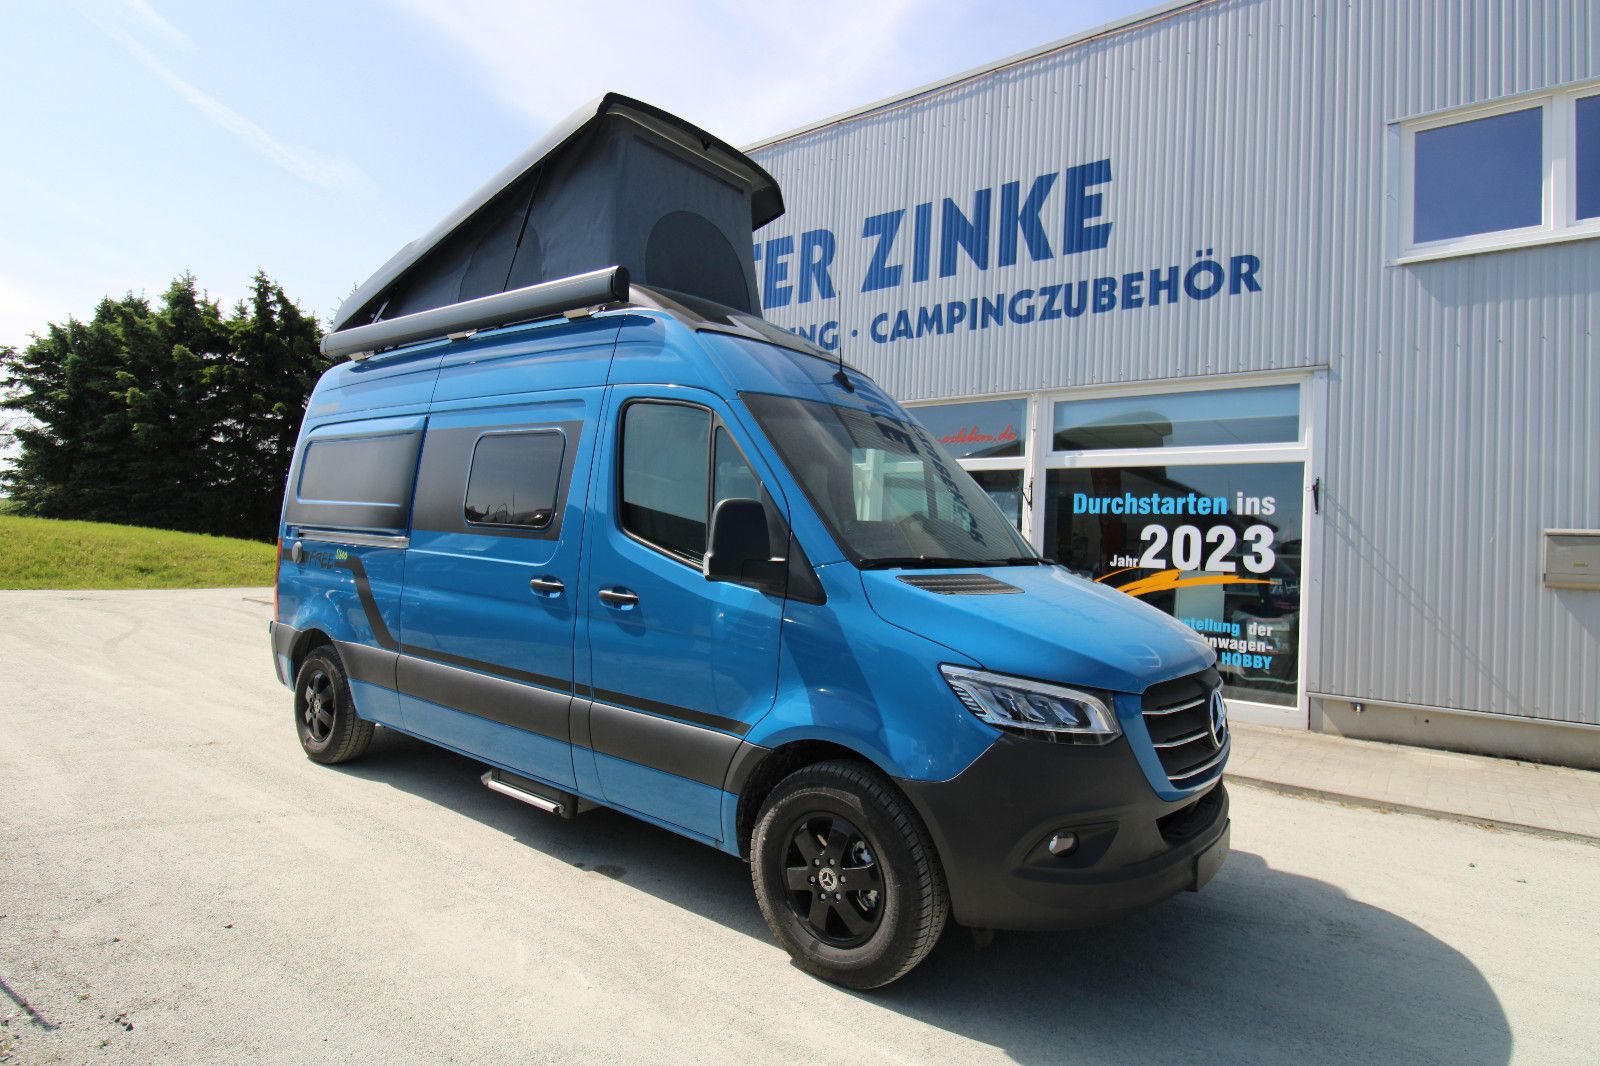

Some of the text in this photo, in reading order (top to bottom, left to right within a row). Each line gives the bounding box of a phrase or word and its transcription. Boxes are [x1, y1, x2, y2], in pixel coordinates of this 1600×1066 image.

[753, 159, 1112, 310] ER ZINKE
[788, 249, 1262, 350] NG CAMPINGZUBEHÖR
[1073, 492, 1276, 516] Durchstarten ins
[1110, 524, 1276, 574] Jahr 2023
[1248, 622, 1273, 636] der
[1221, 652, 1273, 670] HOBBY
